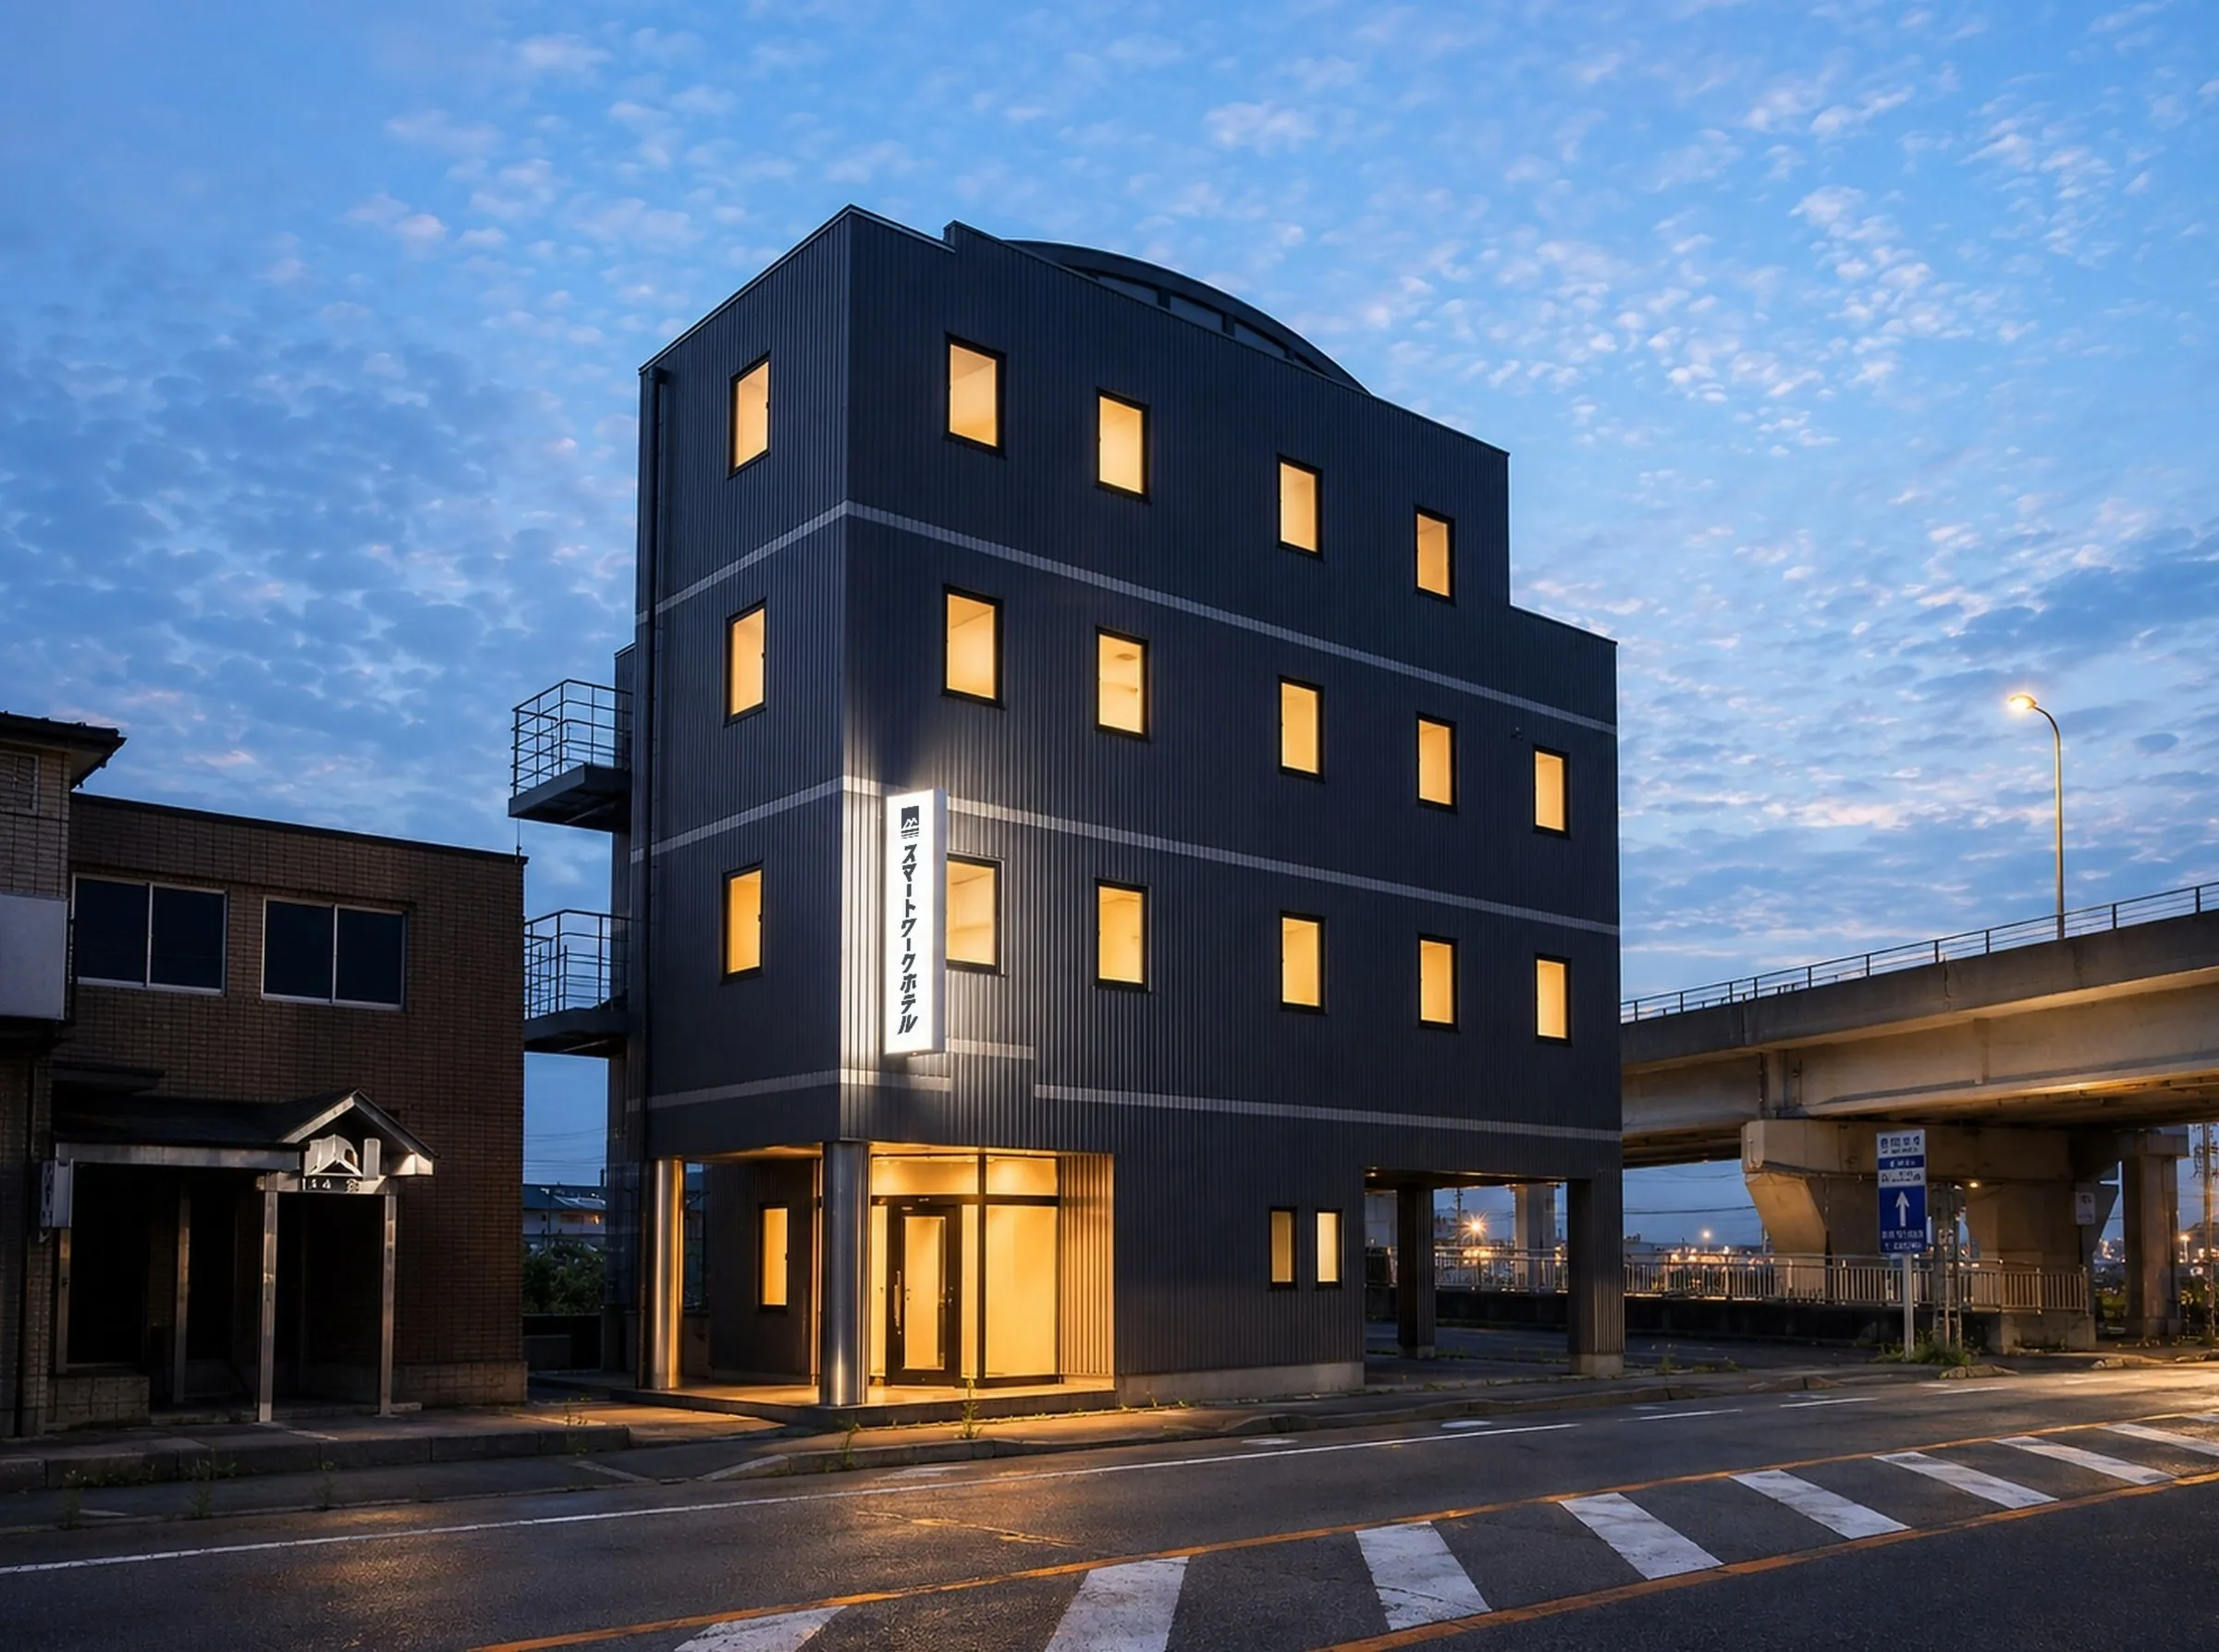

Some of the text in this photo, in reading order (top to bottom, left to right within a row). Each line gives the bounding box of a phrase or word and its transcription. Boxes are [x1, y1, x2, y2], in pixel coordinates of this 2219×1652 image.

[897, 843, 919, 1035] スマートワークホテル
